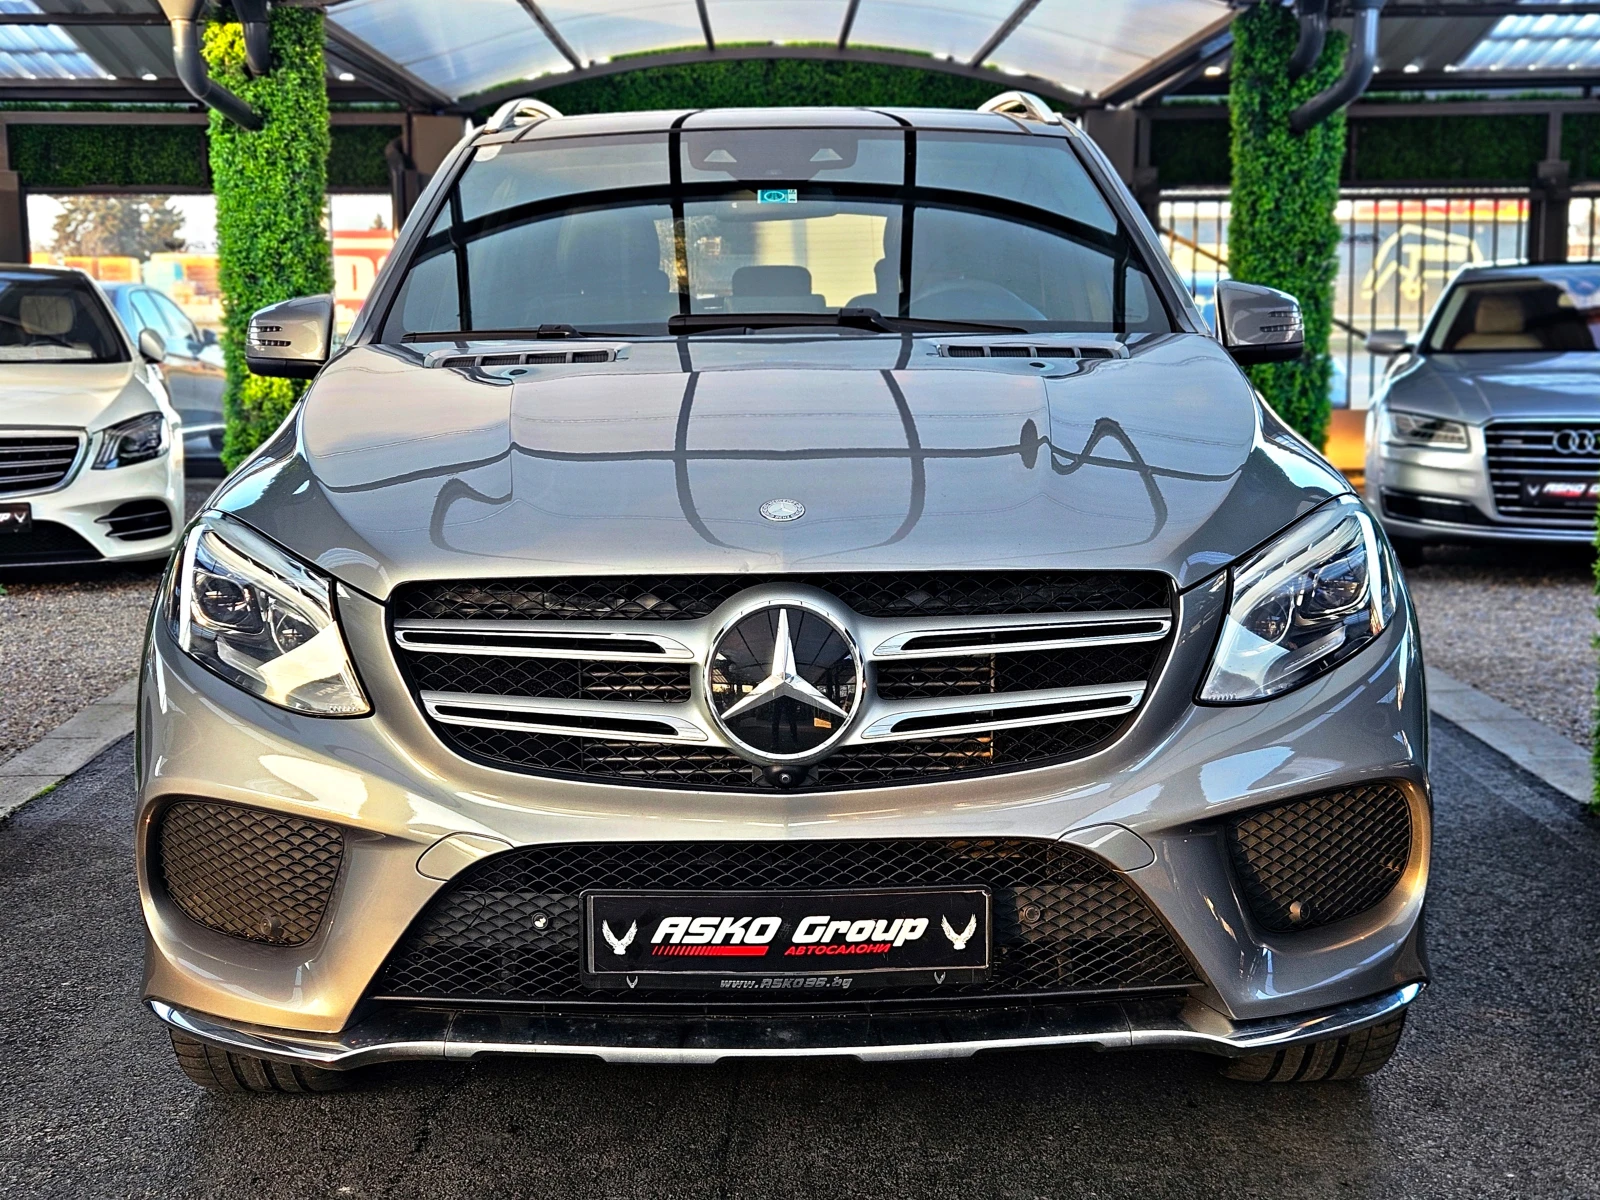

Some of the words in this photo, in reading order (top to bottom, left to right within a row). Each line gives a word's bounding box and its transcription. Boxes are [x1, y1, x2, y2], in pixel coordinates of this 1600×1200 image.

[650, 916, 783, 944] ASKO
[791, 915, 930, 947] Group
[784, 943, 892, 956] АВТОСАЛОНИ
